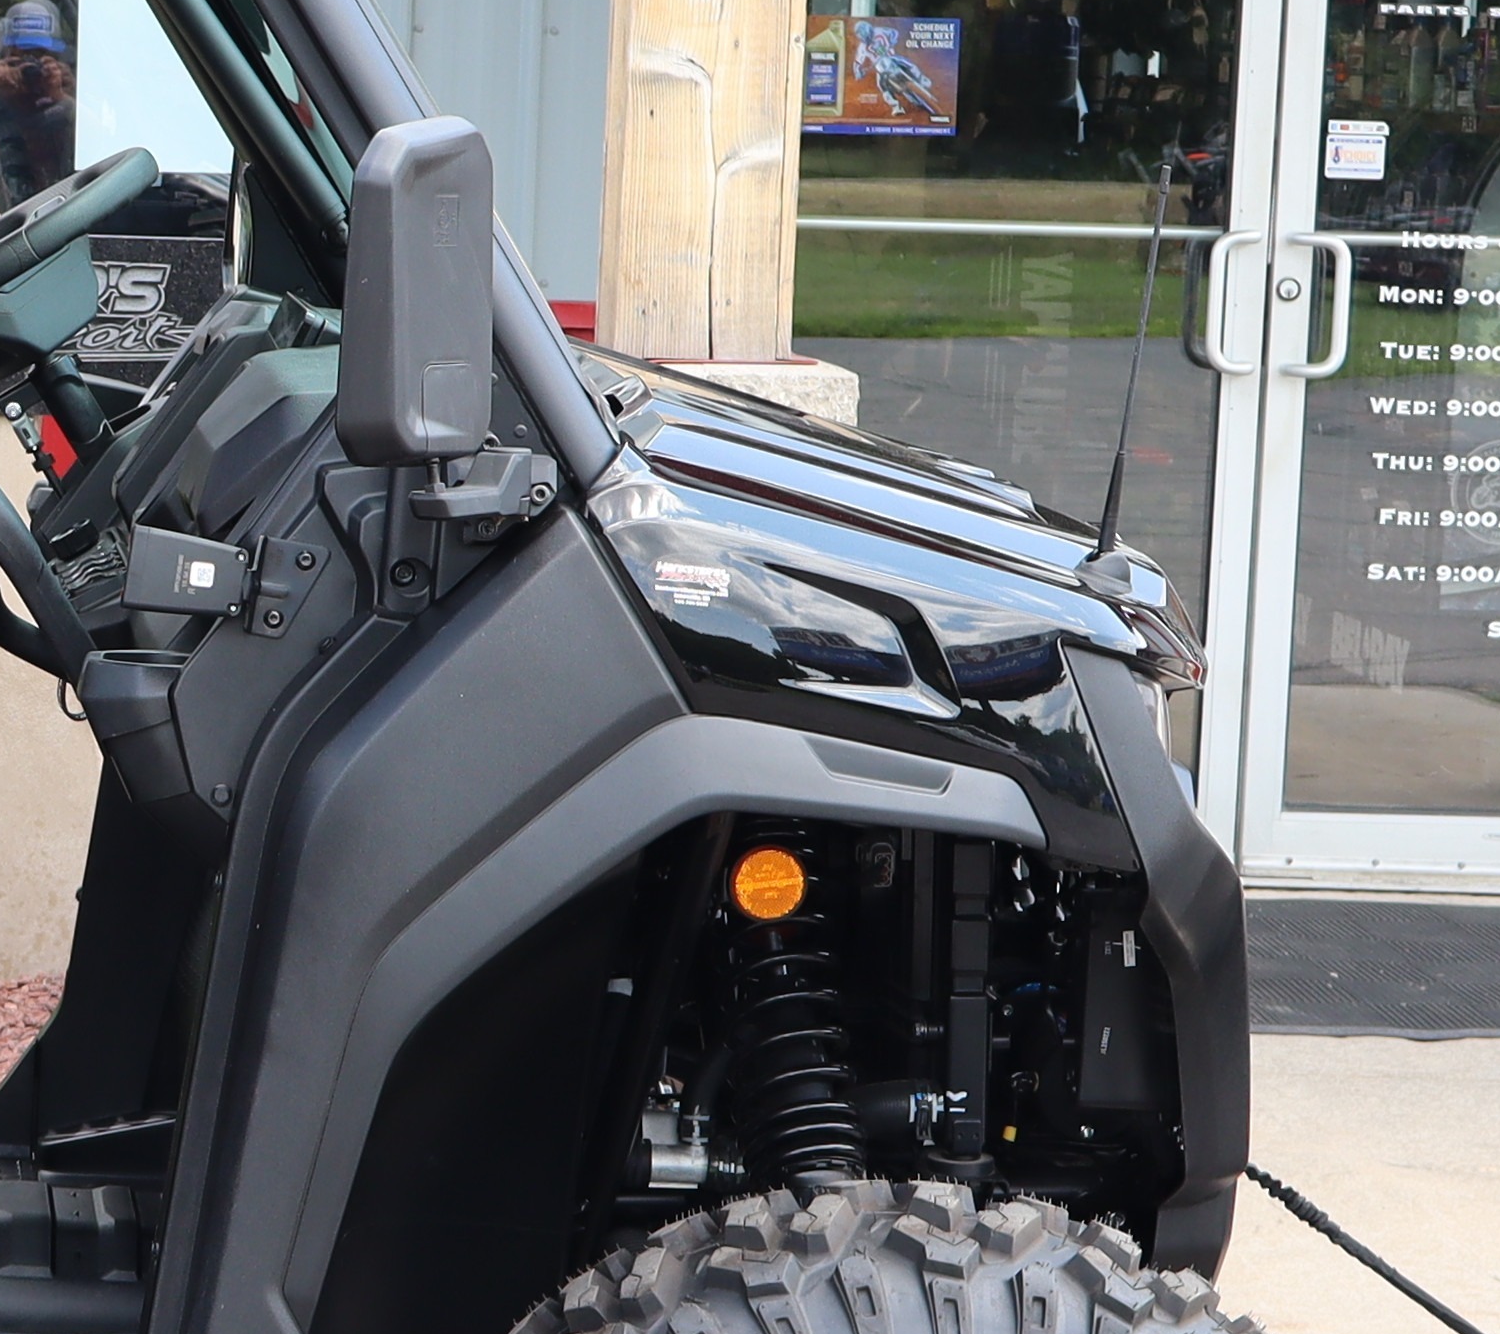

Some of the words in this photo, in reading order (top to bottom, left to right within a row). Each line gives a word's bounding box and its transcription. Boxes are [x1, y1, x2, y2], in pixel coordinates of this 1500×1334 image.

[1379, 3, 1471, 17] PARTS
[913, 22, 955, 32] SCHEDULE
[909, 31, 932, 40] YOUR
[933, 32, 955, 40] NEXT
[905, 40, 919, 49] OIL
[921, 40, 954, 49] CHANGE
